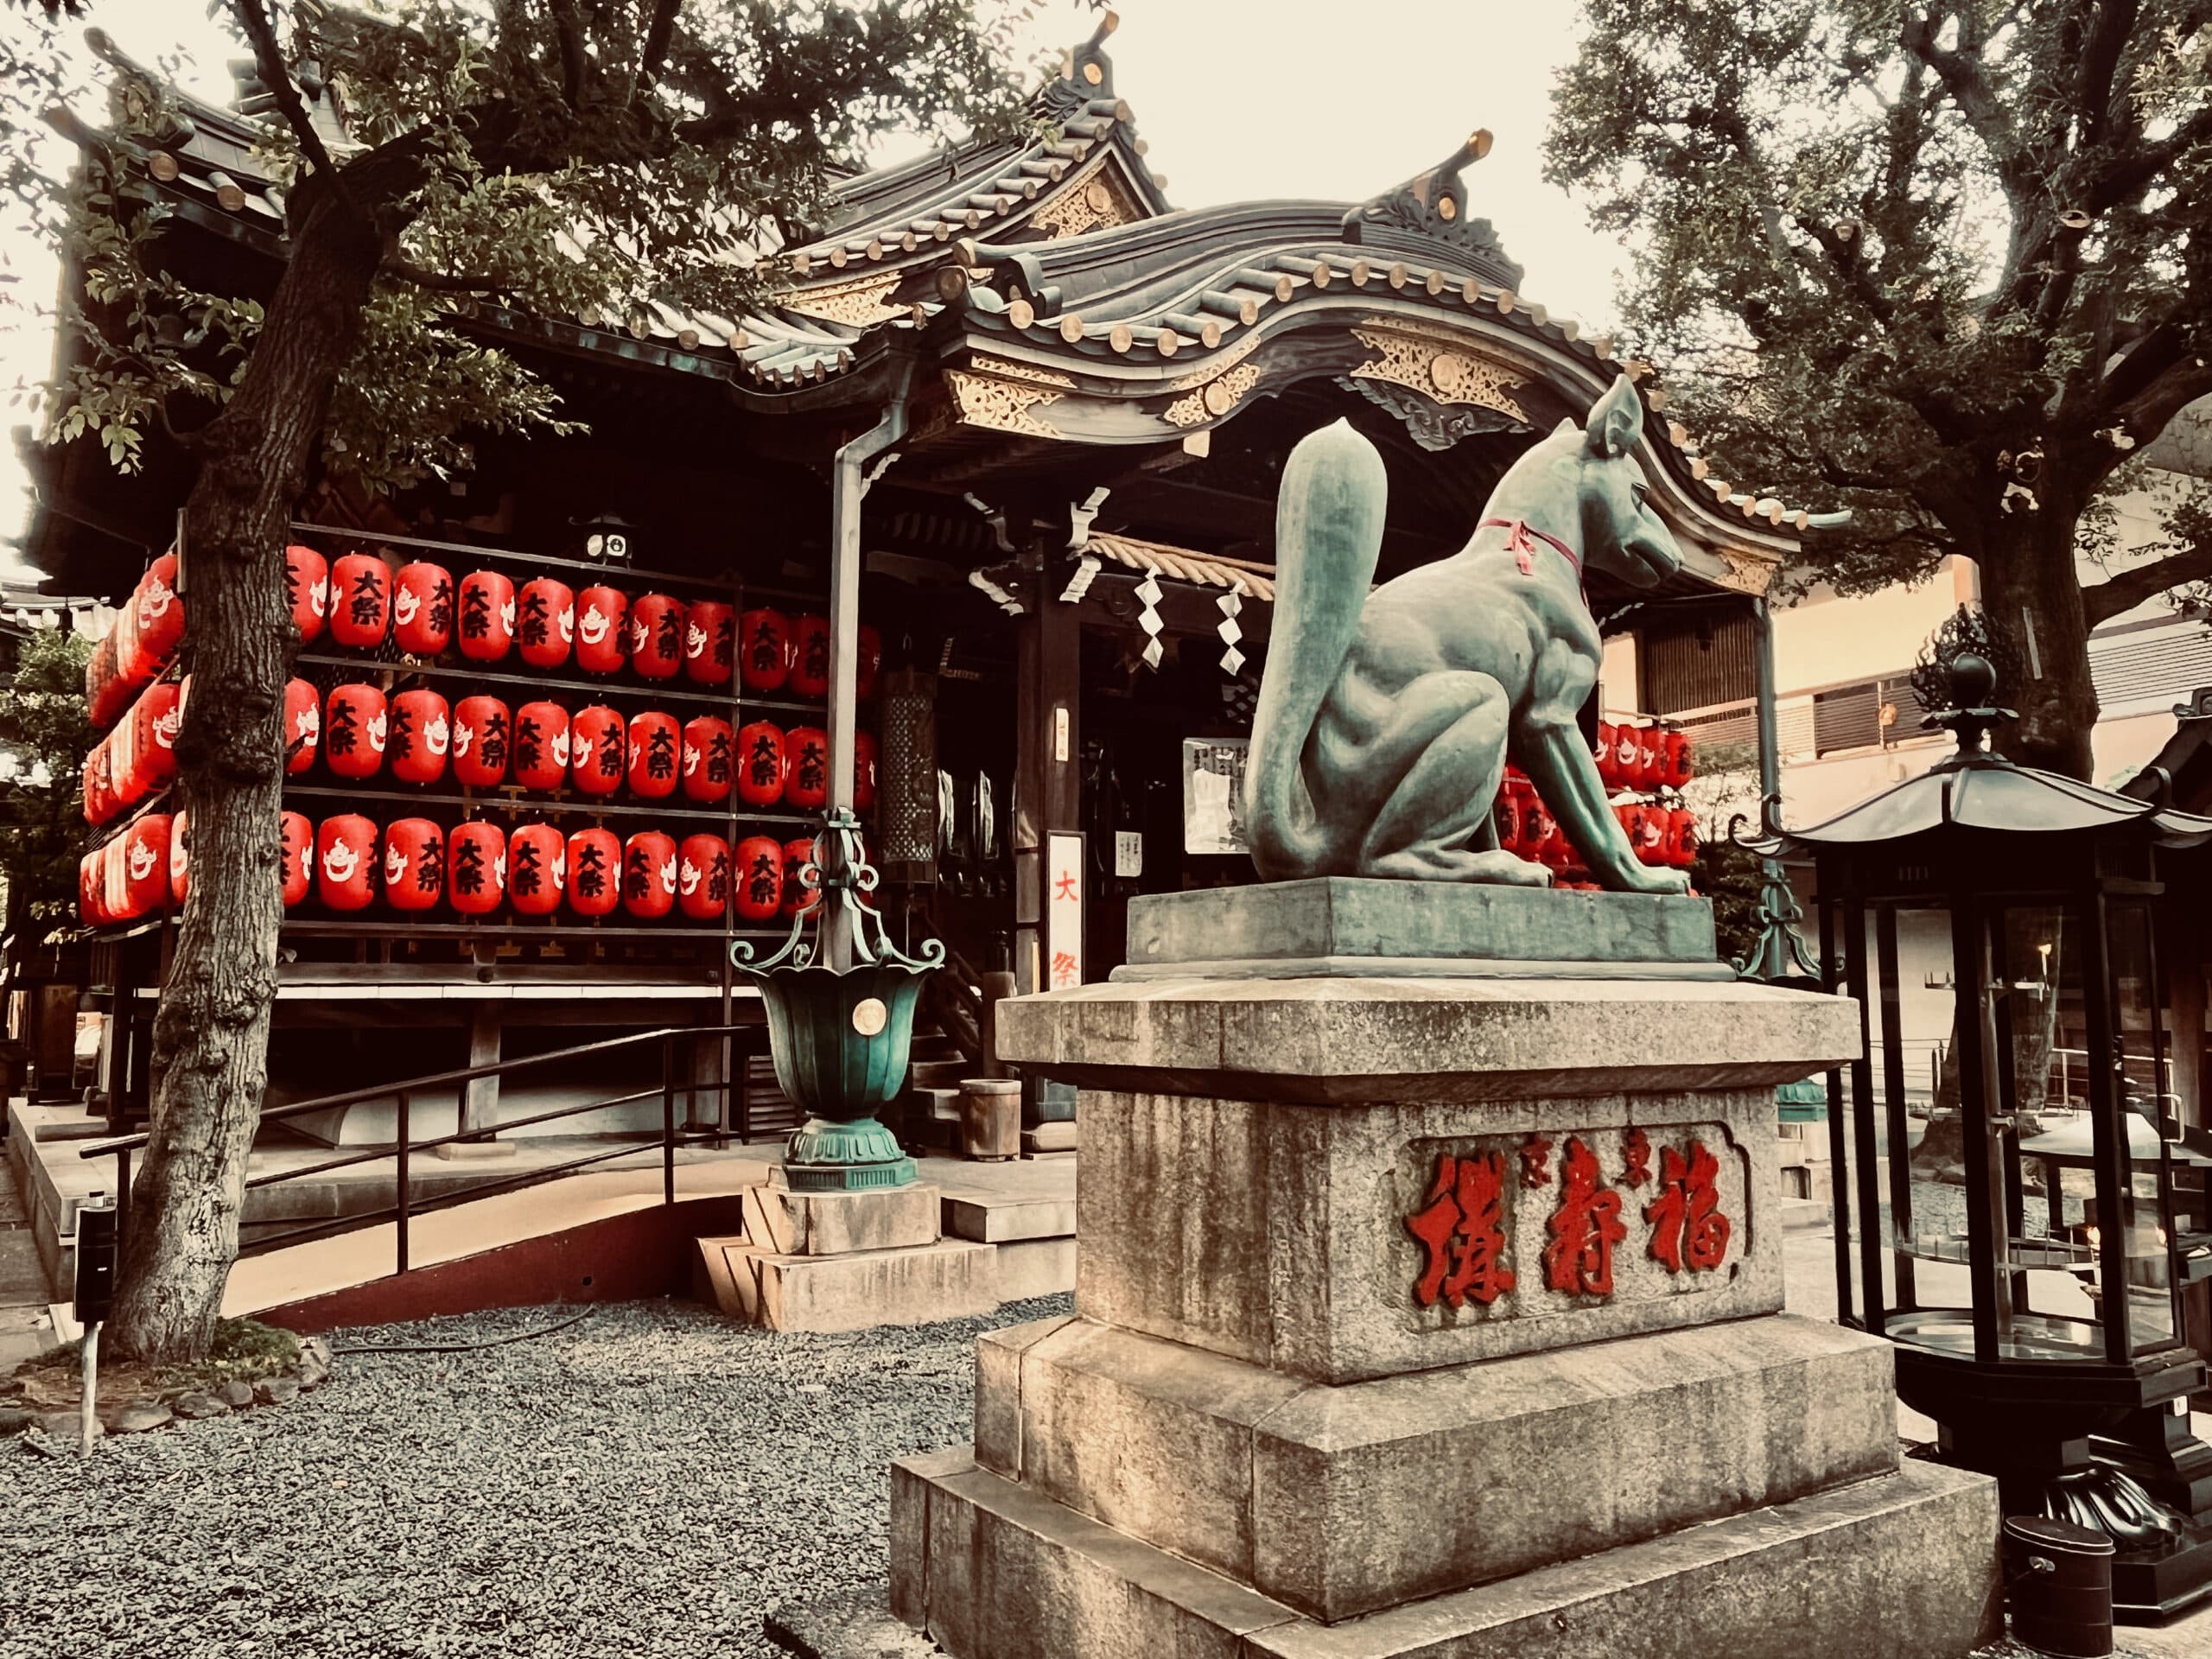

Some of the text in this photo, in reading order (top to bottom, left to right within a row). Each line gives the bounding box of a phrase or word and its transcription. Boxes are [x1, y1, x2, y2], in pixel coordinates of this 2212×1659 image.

[352, 570, 384, 626] 大祭
[429, 579, 453, 634] 大祭
[464, 584, 491, 639] 大祭
[521, 593, 549, 647] 大祭
[657, 609, 682, 658] 大祭
[329, 699, 358, 756] 大祭
[481, 714, 508, 768] 大祭
[517, 717, 543, 771] 大祭
[600, 723, 623, 778] 大祭
[647, 726, 674, 779] 大祭
[708, 732, 732, 784] 大祭
[750, 734, 778, 785] 大祭
[798, 741, 826, 791] 大祭
[418, 837, 443, 893] 大祭
[455, 838, 485, 894] 大祭
[515, 842, 542, 897] 大祭
[578, 843, 606, 898] 大祭
[750, 854, 776, 904] 大祭
[1053, 870, 1078, 986] 大祭
